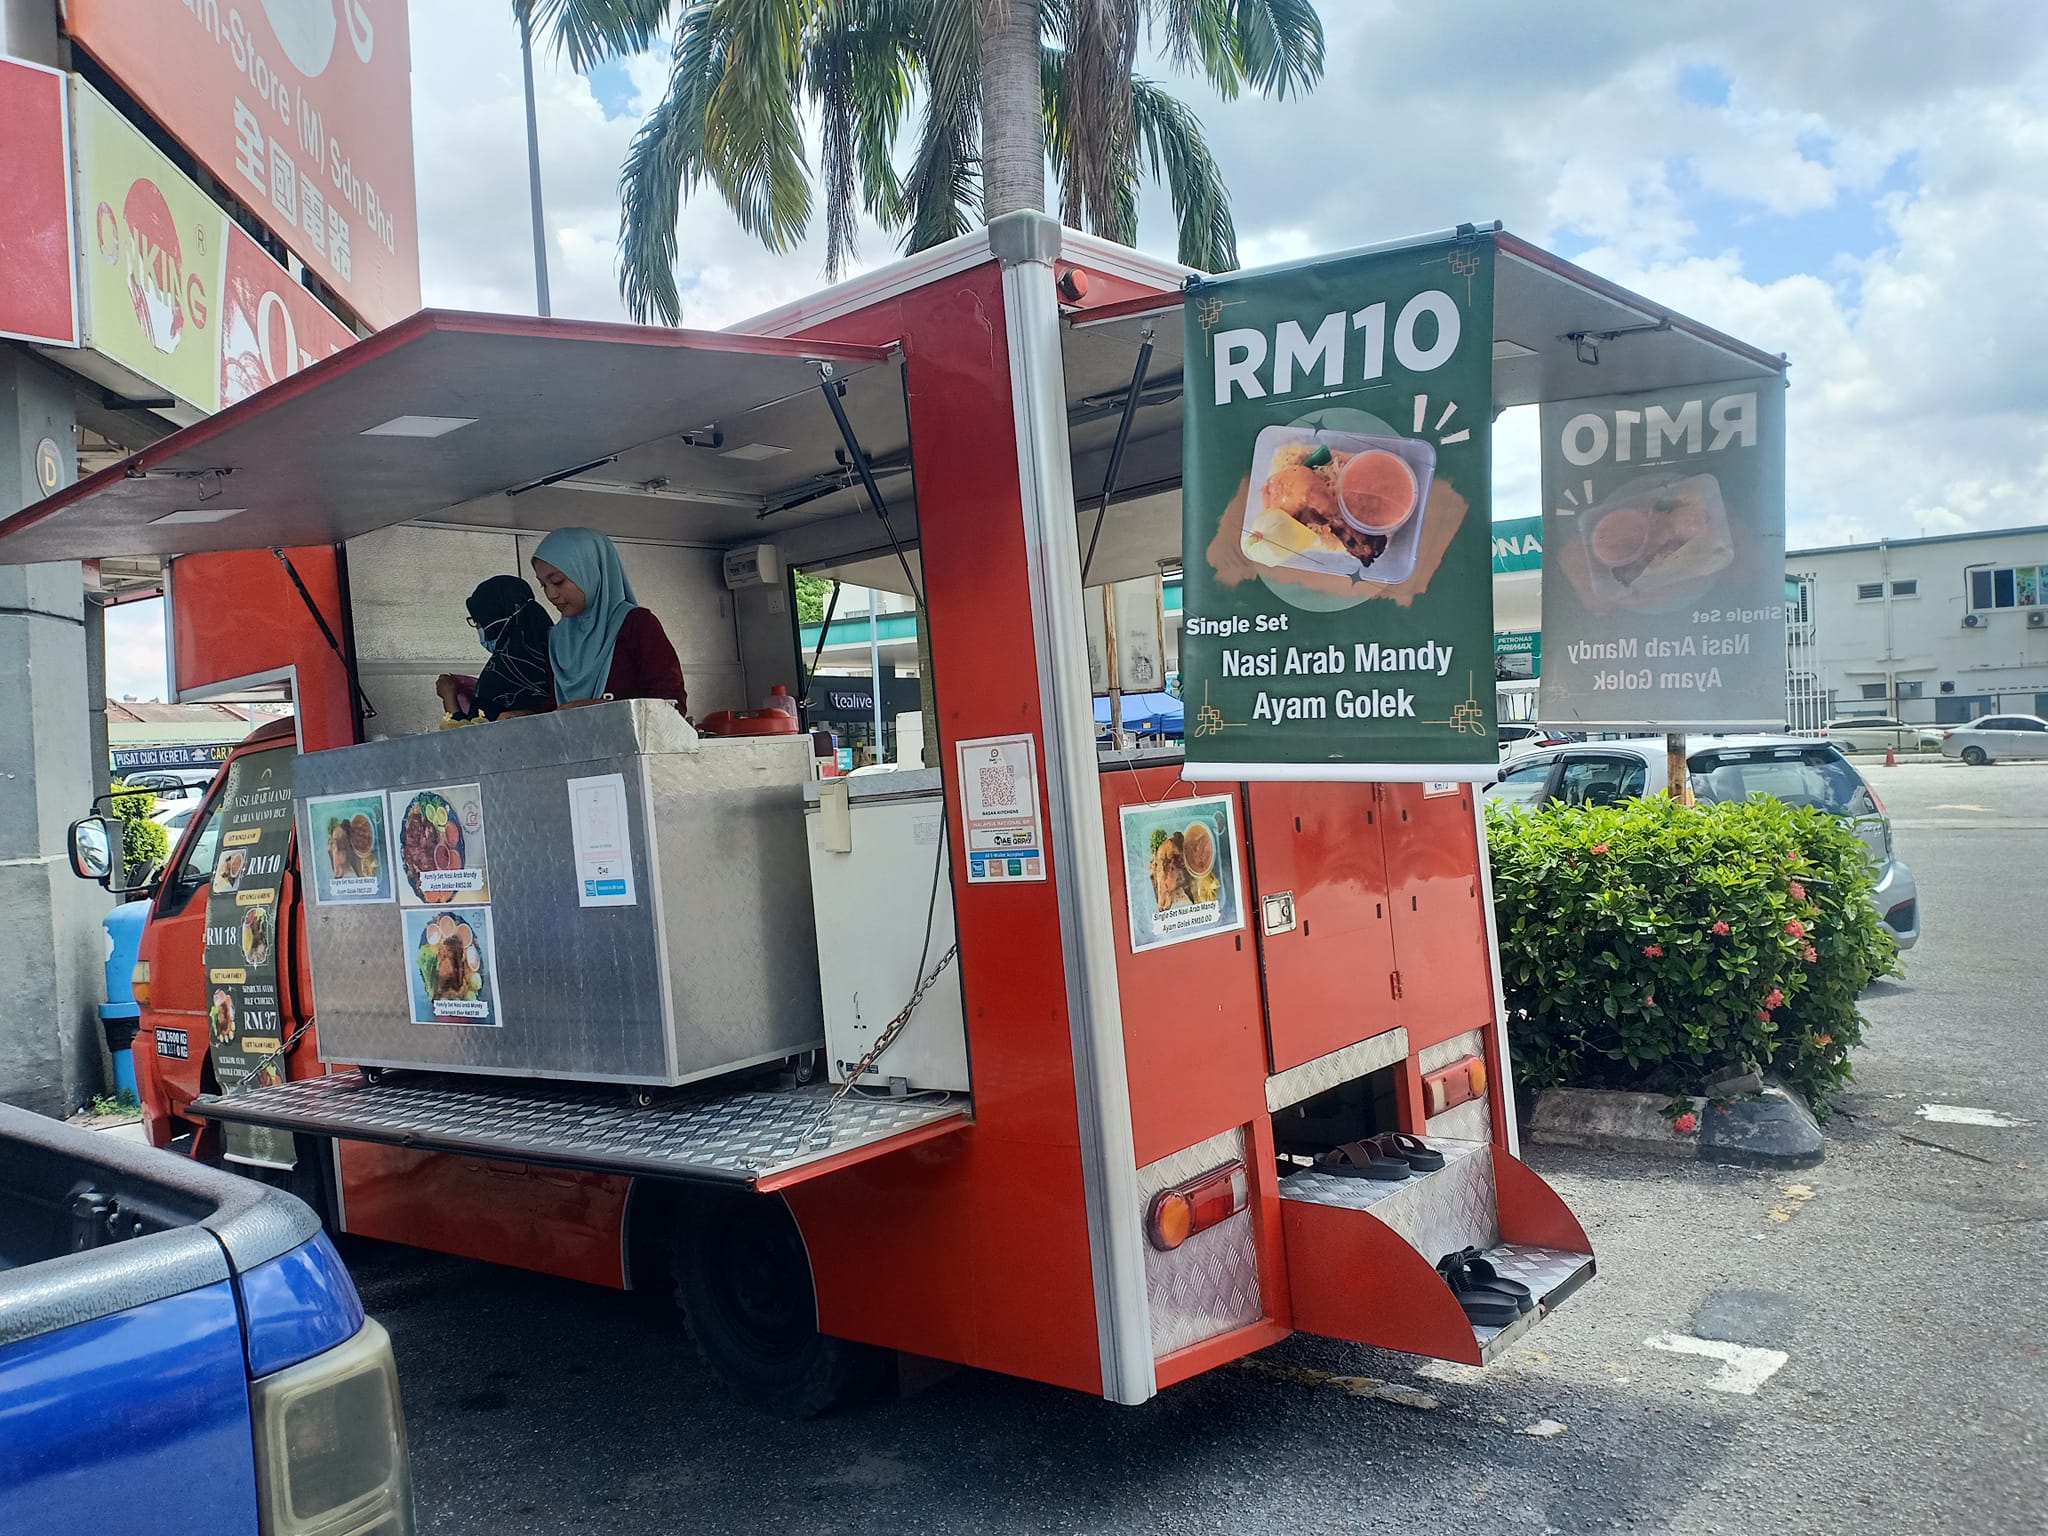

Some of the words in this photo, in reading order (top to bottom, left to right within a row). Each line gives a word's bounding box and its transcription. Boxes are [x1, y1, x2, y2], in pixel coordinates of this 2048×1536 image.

[296, 85, 325, 176] (M)
[329, 137, 362, 215] Sdn
[366, 182, 394, 255] Bhd
[233, 96, 351, 283] 全國電器
[1213, 290, 1461, 406] RM10
[45, 455, 56, 487] D
[1186, 615, 1250, 637] Single
[1255, 613, 1289, 632] Set
[1497, 642, 1533, 651] PRIMAX
[1222, 648, 1277, 677] Nasi
[1283, 645, 1345, 675] Arab
[1354, 640, 1453, 676] Mandy
[834, 693, 873, 708] tealive
[1252, 692, 1327, 725] Ayam
[1335, 689, 1416, 718] Golek
[116, 752, 140, 765] PUSAT
[140, 751, 158, 764] CUCI
[159, 749, 190, 763] KERETA
[210, 747, 228, 760] CAR
[246, 855, 266, 875] RM
[266, 854, 280, 874] 10
[1154, 911, 1169, 921] Single
[1169, 909, 1178, 918] Set
[1178, 907, 1188, 915] Nasi
[1189, 905, 1200, 913] Arab
[1201, 902, 1217, 910] Mandy
[206, 927, 222, 945] RM
[224, 926, 237, 945] 18
[1163, 923, 1176, 933] Ayam
[1177, 920, 1191, 929] Golek
[243, 1011, 263, 1031] RM
[264, 1011, 277, 1031] 37
